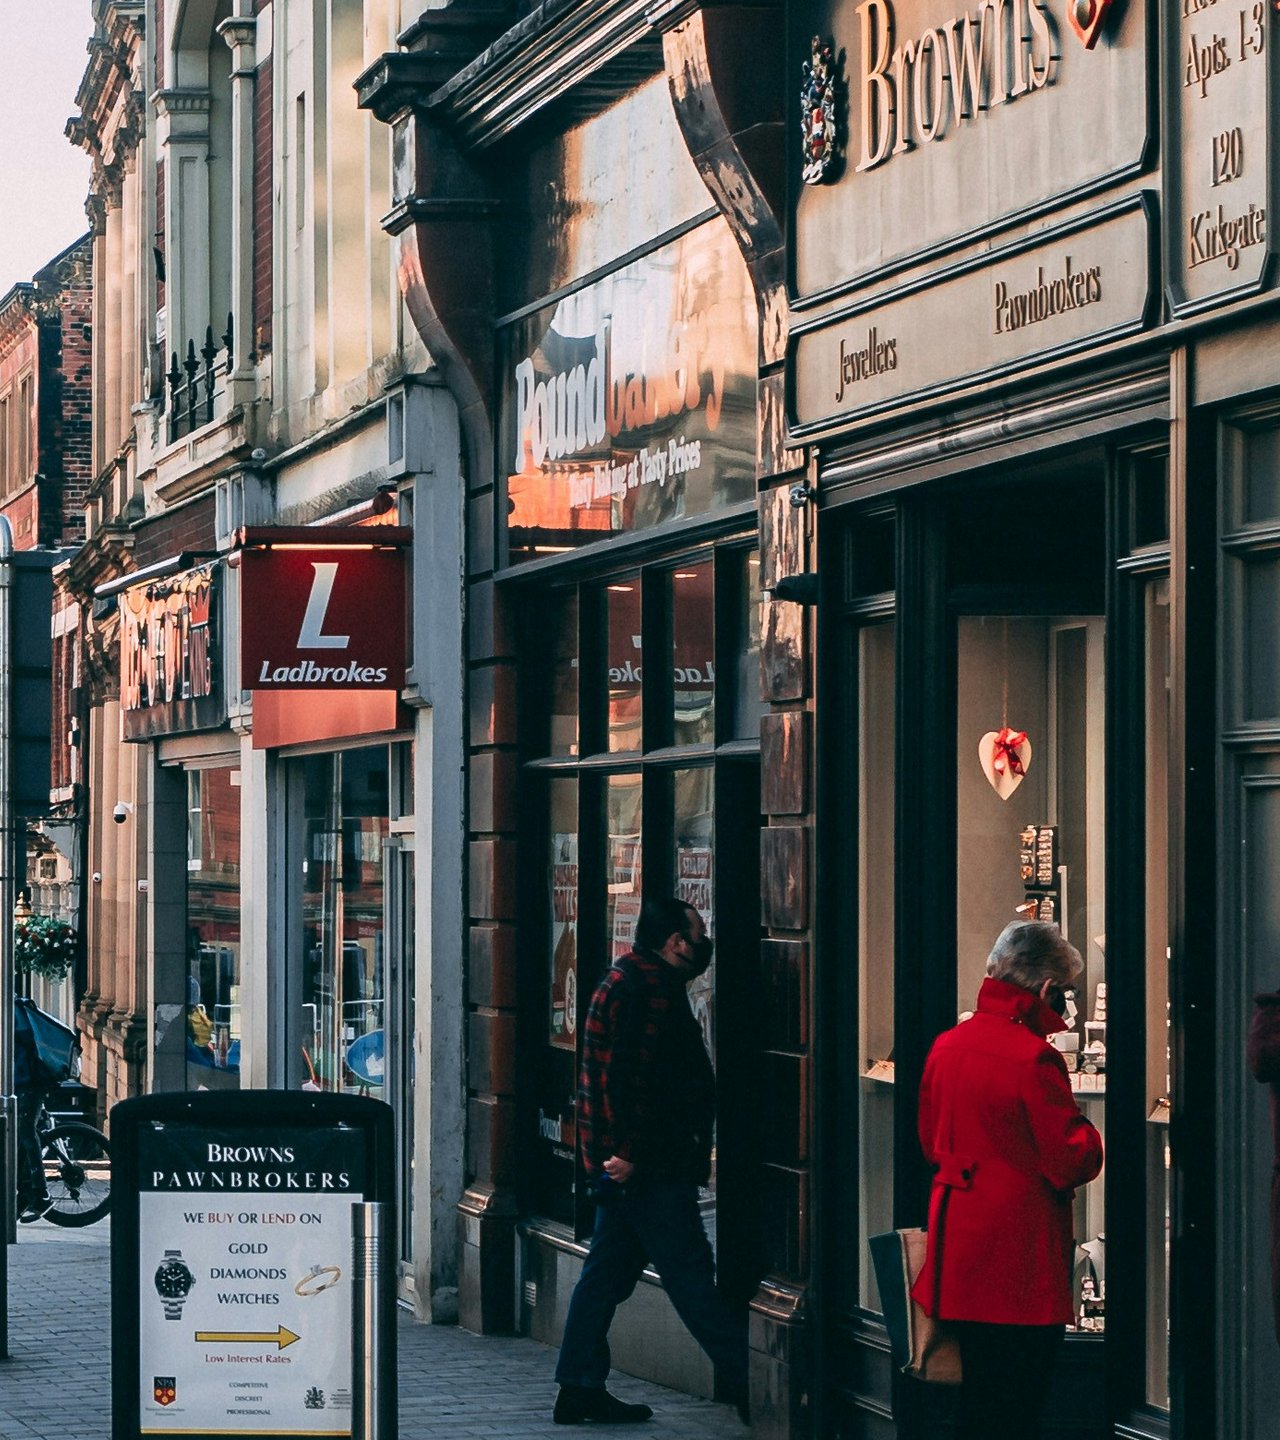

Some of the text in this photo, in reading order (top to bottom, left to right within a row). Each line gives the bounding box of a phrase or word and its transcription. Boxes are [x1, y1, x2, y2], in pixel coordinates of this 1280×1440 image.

[1210, 126, 1244, 187] 120
[1188, 202, 1267, 271] Kirkgate
[993, 255, 1102, 335] Pawnbrokers
[835, 326, 897, 402] Jewellers
[639, 447, 667, 487] Tasty
[668, 436, 702, 476] Prices
[296, 562, 350, 649] L
[258, 660, 387, 684] Ladbrokes
[207, 1143, 295, 1163] BROWNS
[152, 1171, 350, 1188] PAWNBROKERS
[183, 1212, 322, 1224] WE BUY OR LEND ON
[228, 1242, 268, 1255] GOLD
[210, 1267, 287, 1280] DIAMONDS
[217, 1292, 280, 1305] WATCHES
[205, 1353, 292, 1364] Low Interest Rates
[156, 1379, 174, 1387] NPA
